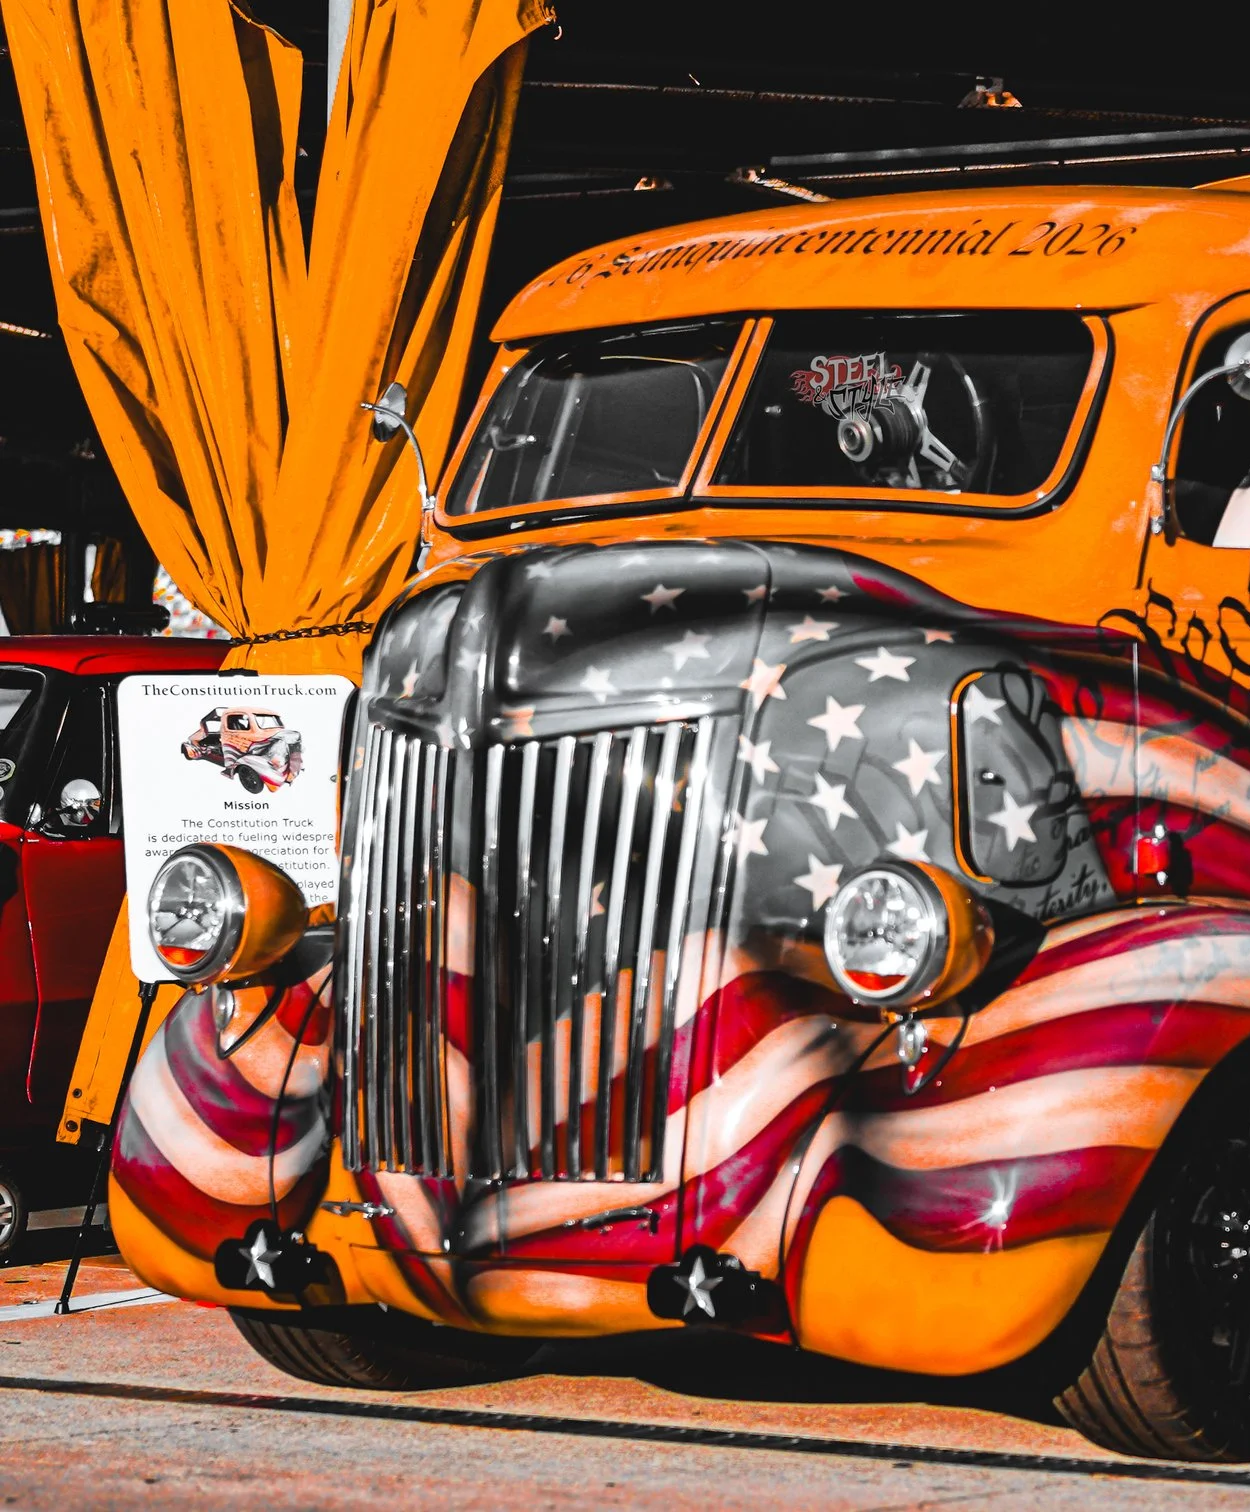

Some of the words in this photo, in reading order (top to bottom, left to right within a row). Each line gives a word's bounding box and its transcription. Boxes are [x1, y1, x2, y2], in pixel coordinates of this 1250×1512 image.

[1008, 221, 1138, 257] 2026
[810, 351, 894, 389] STEEL
[813, 386, 825, 403] &
[142, 684, 337, 696] TheConstitutionTruck.com
[224, 801, 269, 810] Mission
[182, 819, 203, 828] The
[208, 818, 278, 828] Constitution
[282, 818, 313, 827] Truck
[148, 834, 157, 843] is
[162, 833, 218, 843] dedicated
[222, 834, 234, 842] to
[238, 833, 278, 844] fueling
[282, 833, 334, 844] widespre
[313, 846, 328, 855] for
[279, 861, 330, 870] stitution.
[310, 893, 328, 903] the
